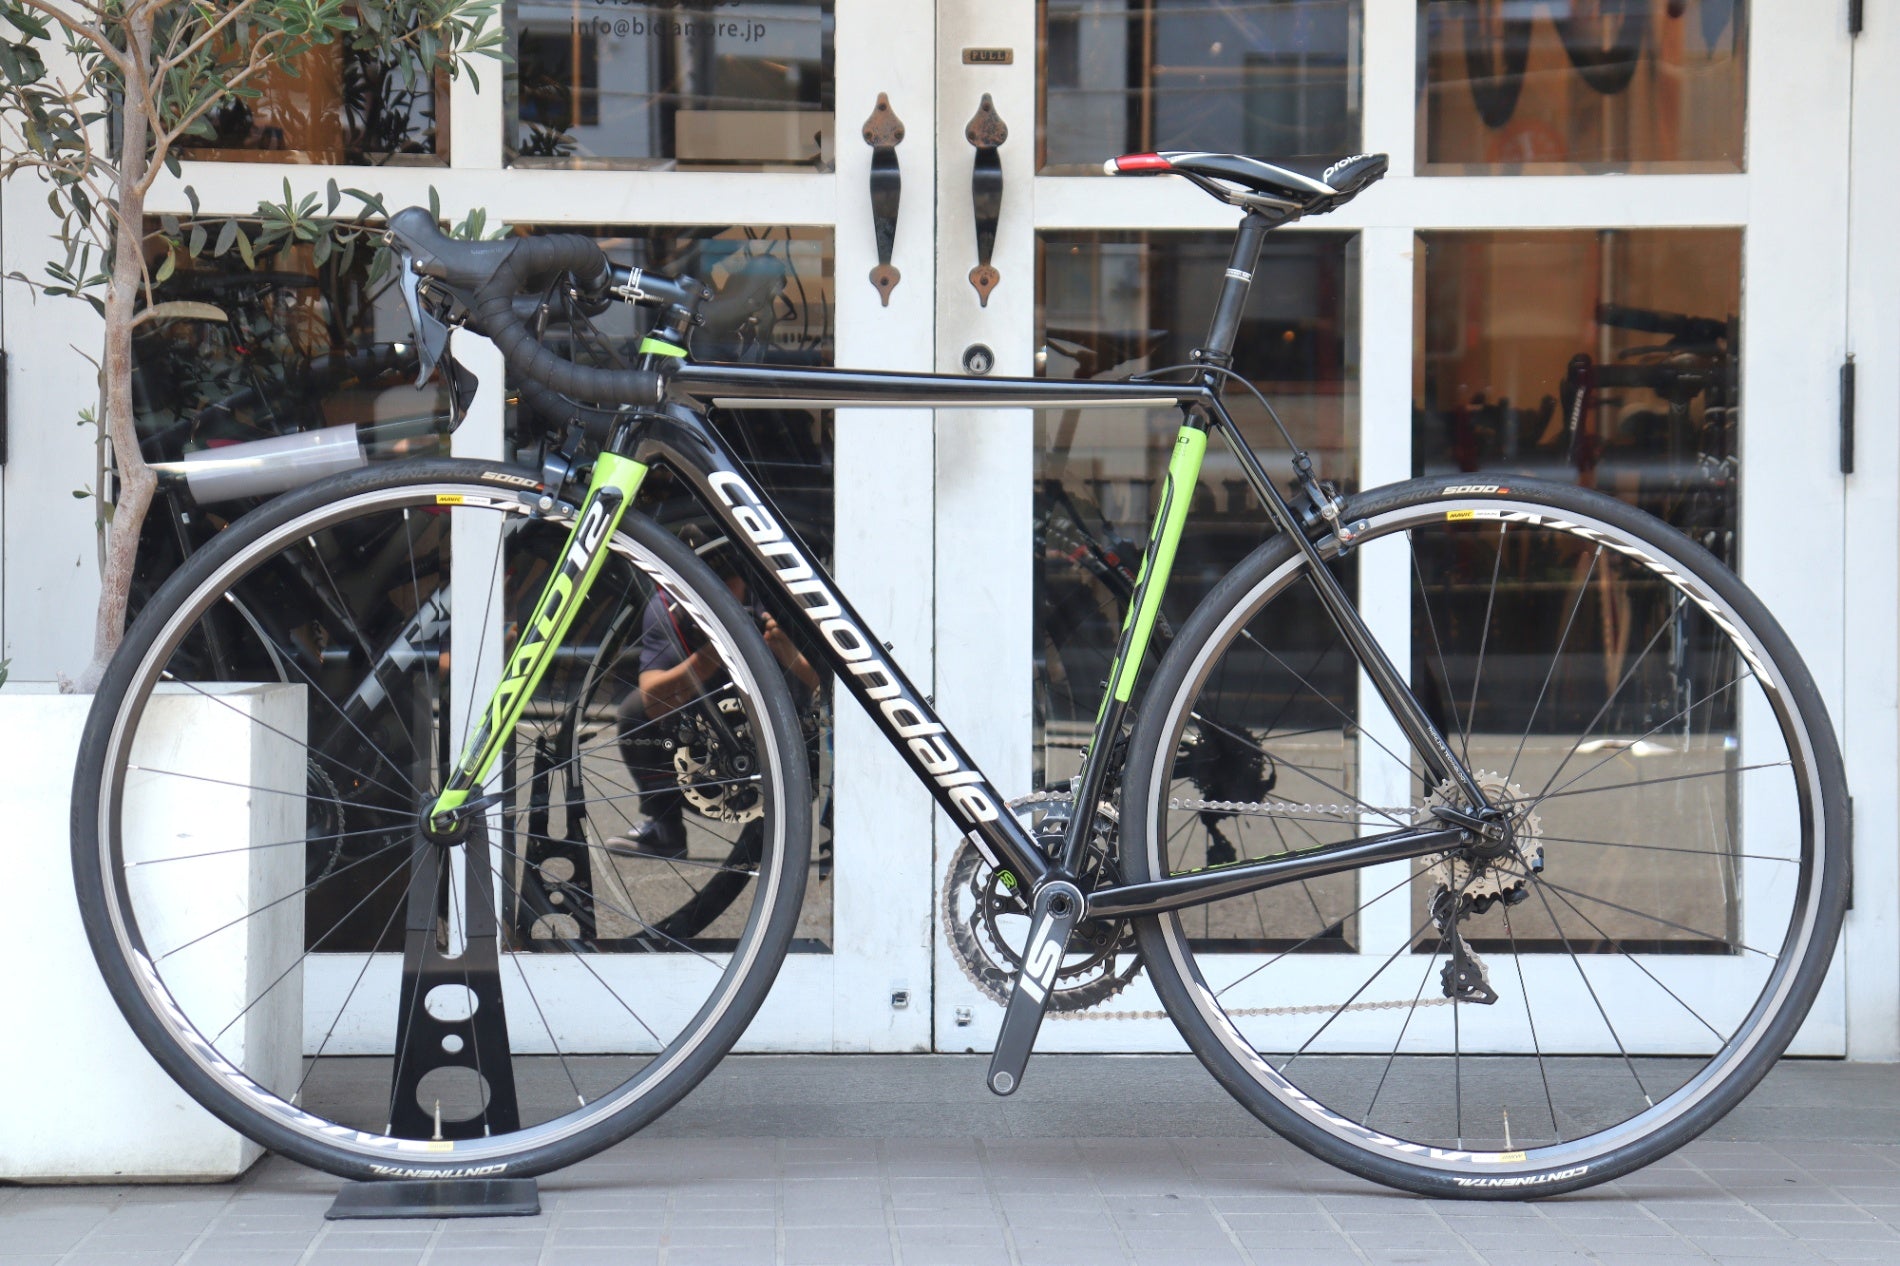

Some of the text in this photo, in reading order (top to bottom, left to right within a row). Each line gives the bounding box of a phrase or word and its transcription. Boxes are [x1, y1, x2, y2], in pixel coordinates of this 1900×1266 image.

[971, 50, 1005, 60] PULL
[481, 471, 538, 488] 5000
[1442, 485, 1500, 496] 5000
[707, 470, 1000, 824] cannondale
[369, 1163, 509, 1179] CONTINENTAL
[1452, 1166, 1589, 1187] CONTINENTAL
